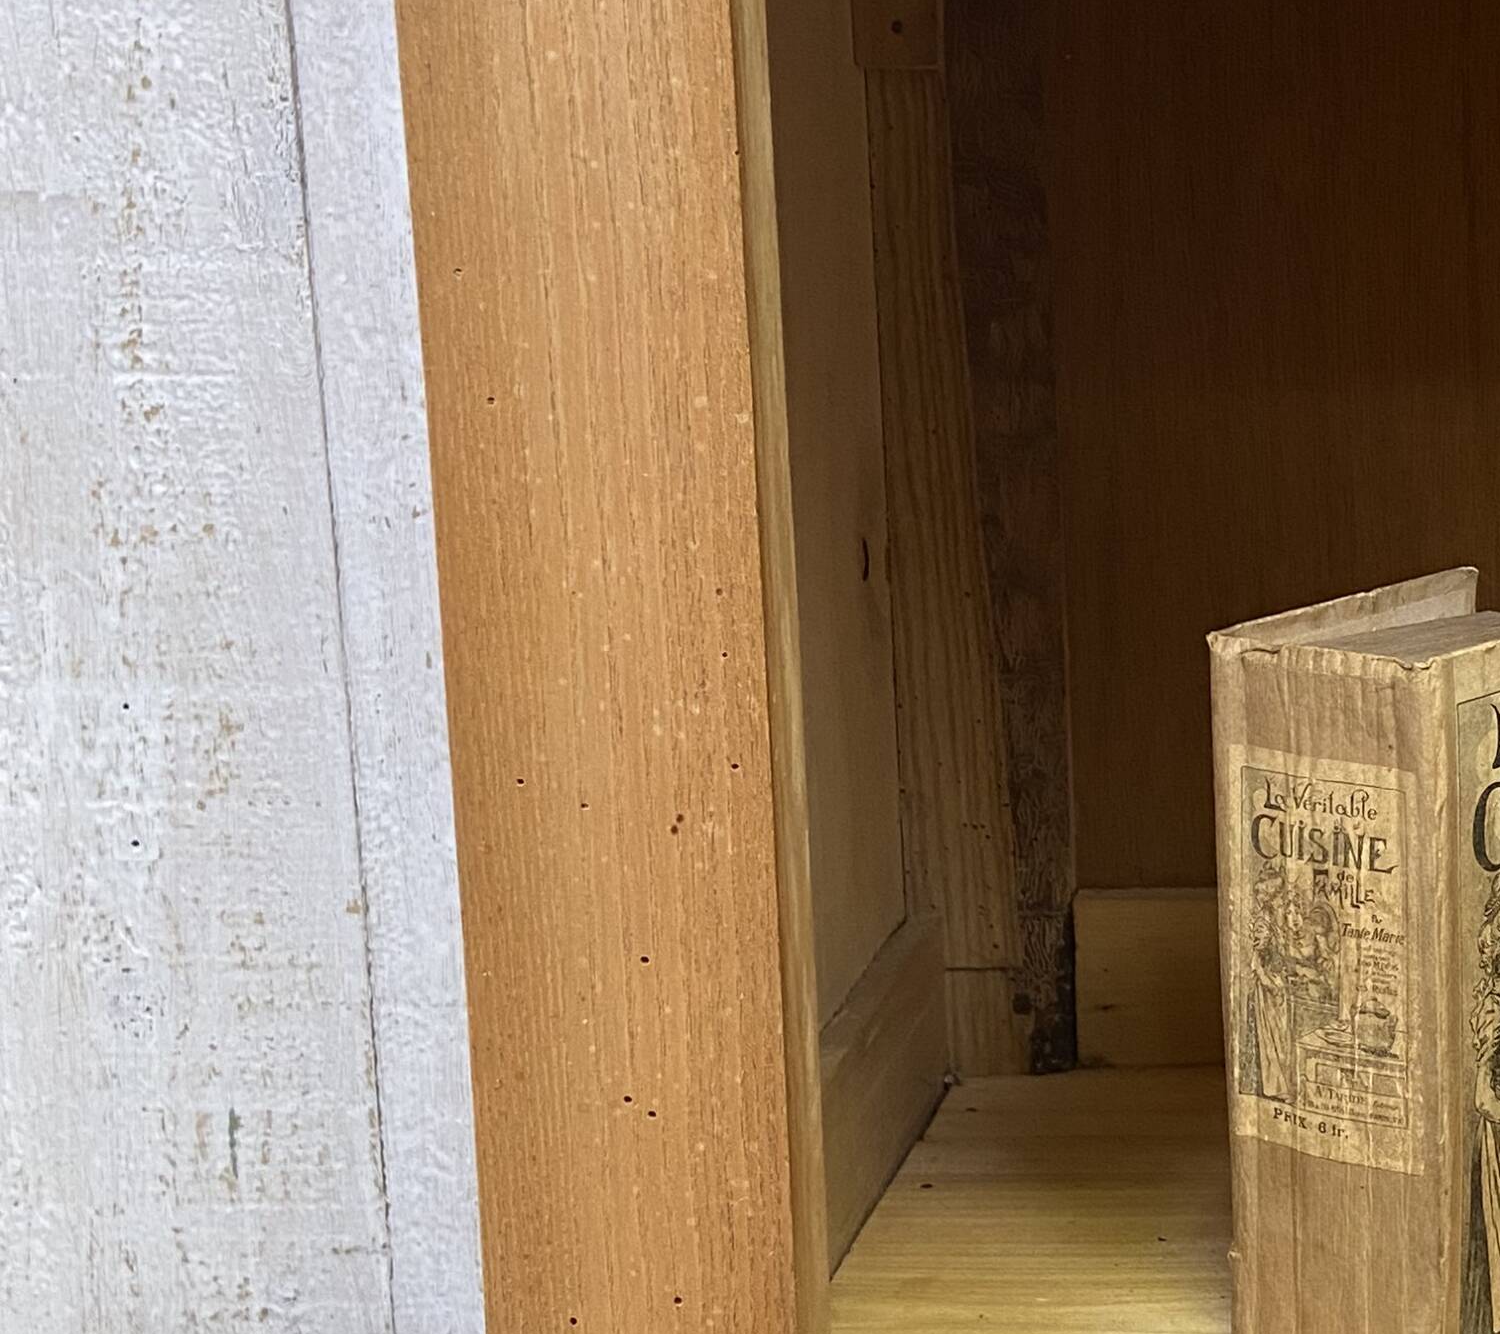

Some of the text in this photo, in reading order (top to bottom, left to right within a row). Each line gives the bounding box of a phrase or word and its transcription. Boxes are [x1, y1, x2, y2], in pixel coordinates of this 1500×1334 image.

[1264, 776, 1287, 813] La
[1250, 813, 1399, 875] CUISINE
[1312, 868, 1376, 910] FAMILLE
[1337, 869, 1355, 884] de
[1342, 923, 1370, 941] Tante
[1273, 1107, 1308, 1130] PRIX
[1318, 1121, 1327, 1134] 6
